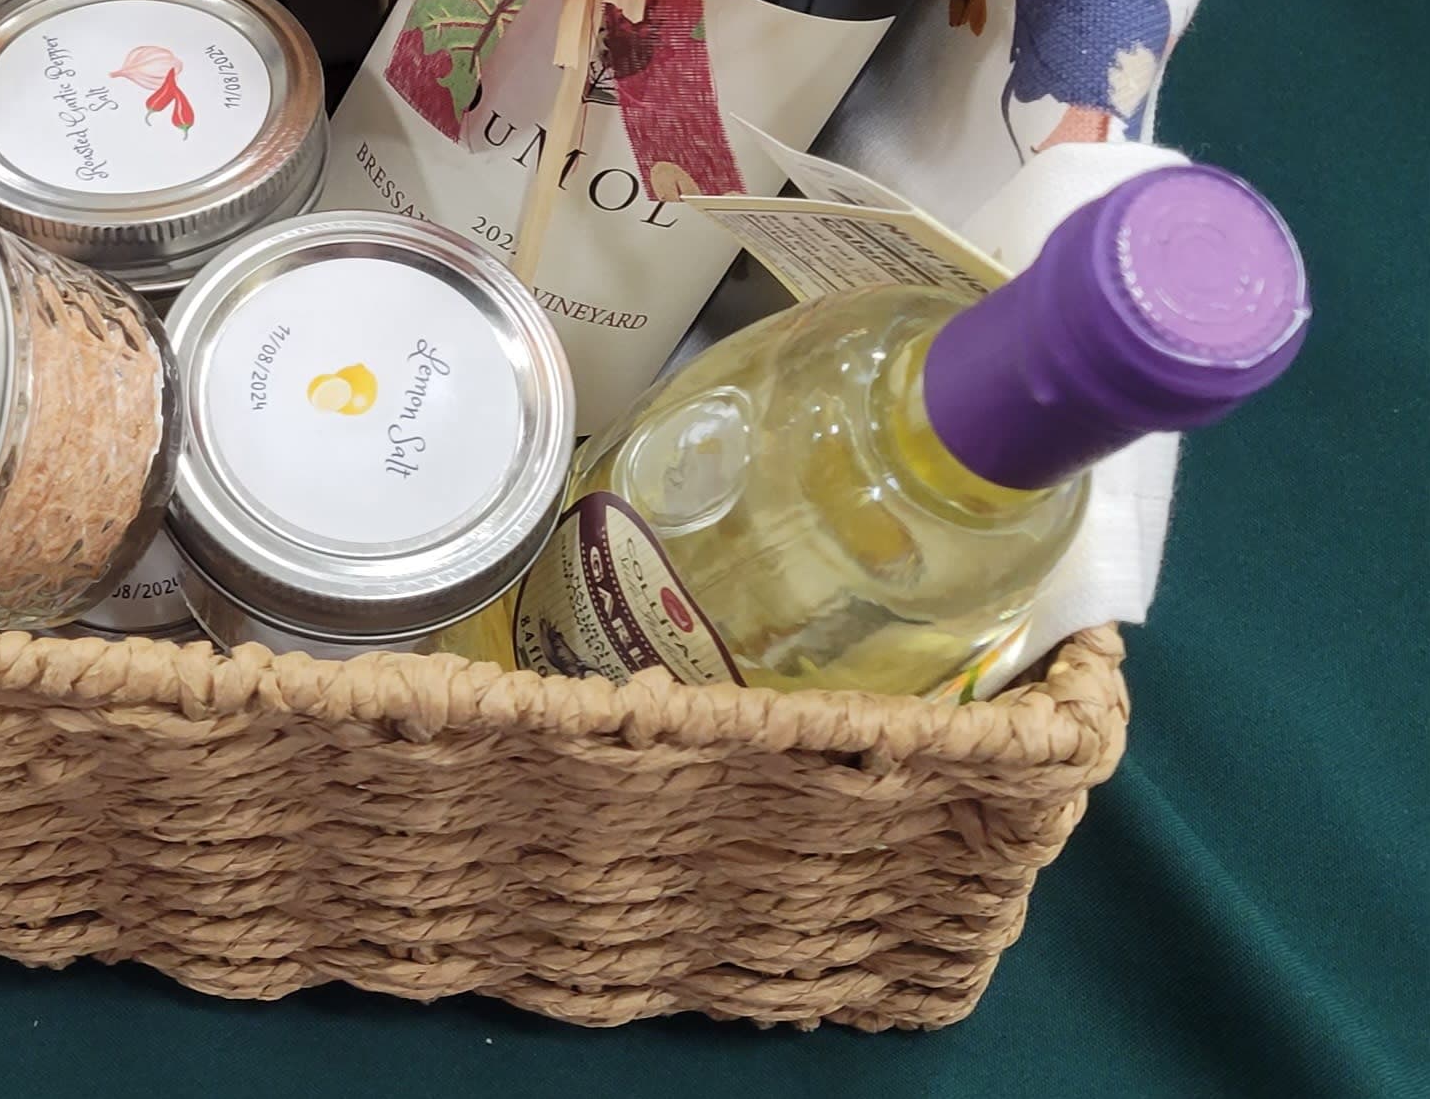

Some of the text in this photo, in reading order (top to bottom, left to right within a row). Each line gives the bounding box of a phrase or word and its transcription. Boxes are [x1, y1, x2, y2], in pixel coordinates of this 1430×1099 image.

[43, 35, 109, 181] Roasted Garlic Pepper
[85, 86, 119, 112] Salt
[204, 44, 242, 110] 11/08/2024
[471, 215, 518, 255] 202
[878, 222, 989, 294] Nutritio
[250, 324, 290, 410] 11/08/2024
[384, 338, 451, 479] Lemon Salt
[589, 545, 648, 669] GARL
